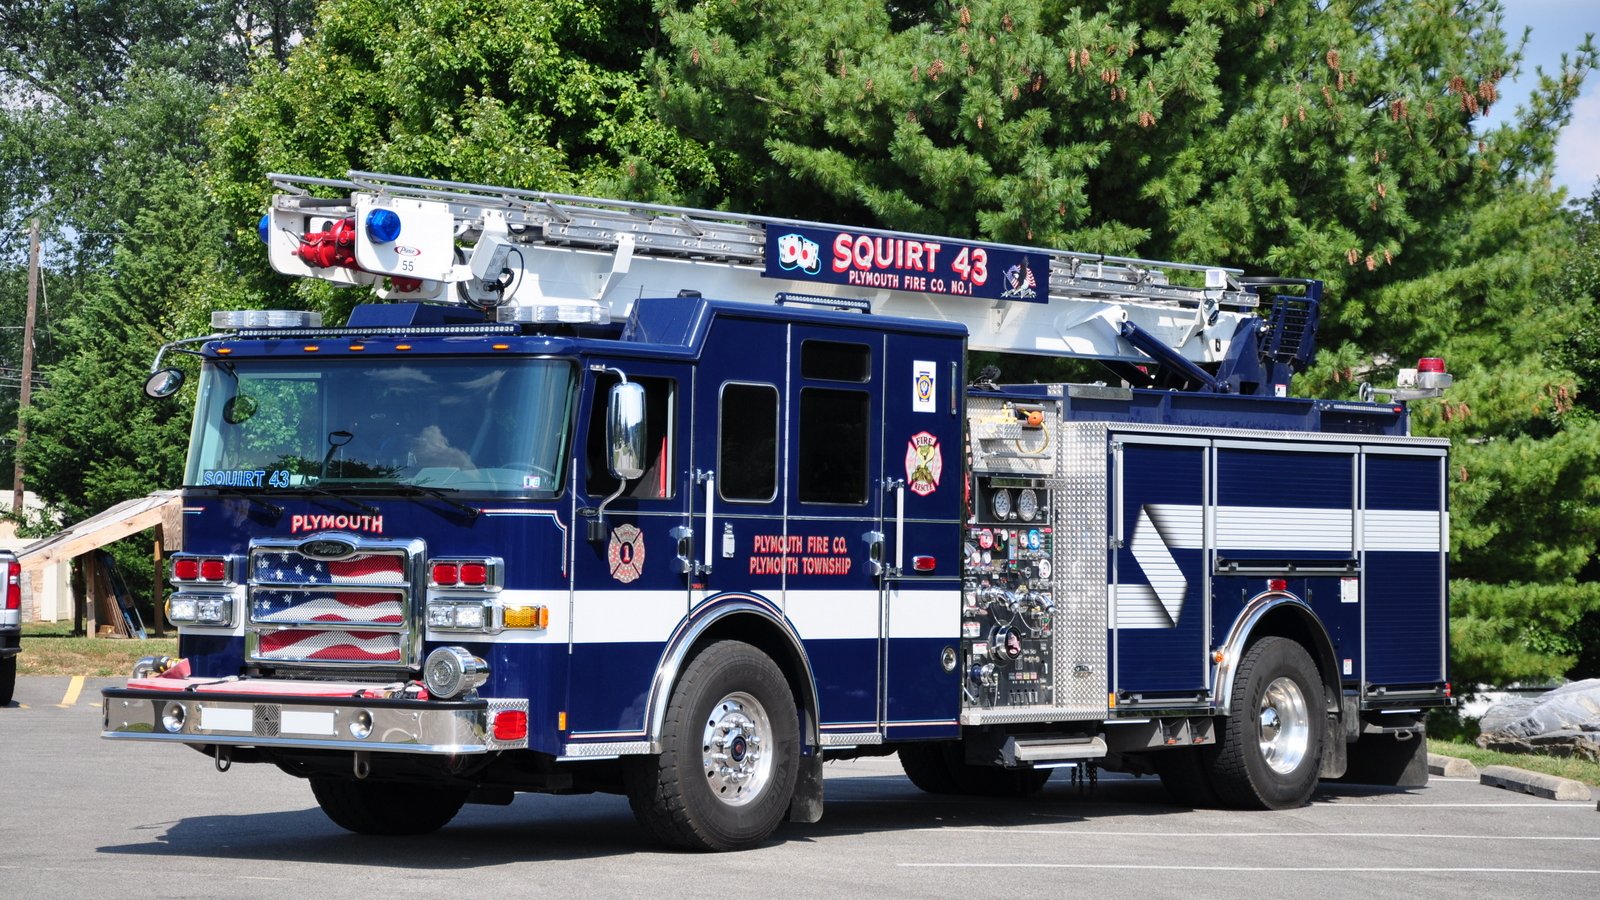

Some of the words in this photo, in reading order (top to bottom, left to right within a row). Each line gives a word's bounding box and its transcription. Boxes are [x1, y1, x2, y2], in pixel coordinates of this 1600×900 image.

[402, 260, 414, 272] 55
[832, 233, 941, 273] SQUIRT
[951, 247, 988, 286] 43
[849, 270, 899, 289] PLYMOUTH
[904, 275, 926, 291] FIRE
[930, 278, 947, 293] CO.
[915, 436, 933, 446] FIRE
[203, 471, 265, 487] SQUIRT
[268, 470, 290, 488] 43
[914, 482, 933, 492] RESCUE
[291, 515, 384, 534] PLYMOUTH
[623, 544, 630, 563] 1
[754, 535, 803, 554] PLYMOUTH
[807, 536, 829, 554] FIRE
[832, 536, 848, 554] CO.
[749, 556, 799, 575] PLYMOUTH
[801, 557, 852, 575] TOWNSHIP
